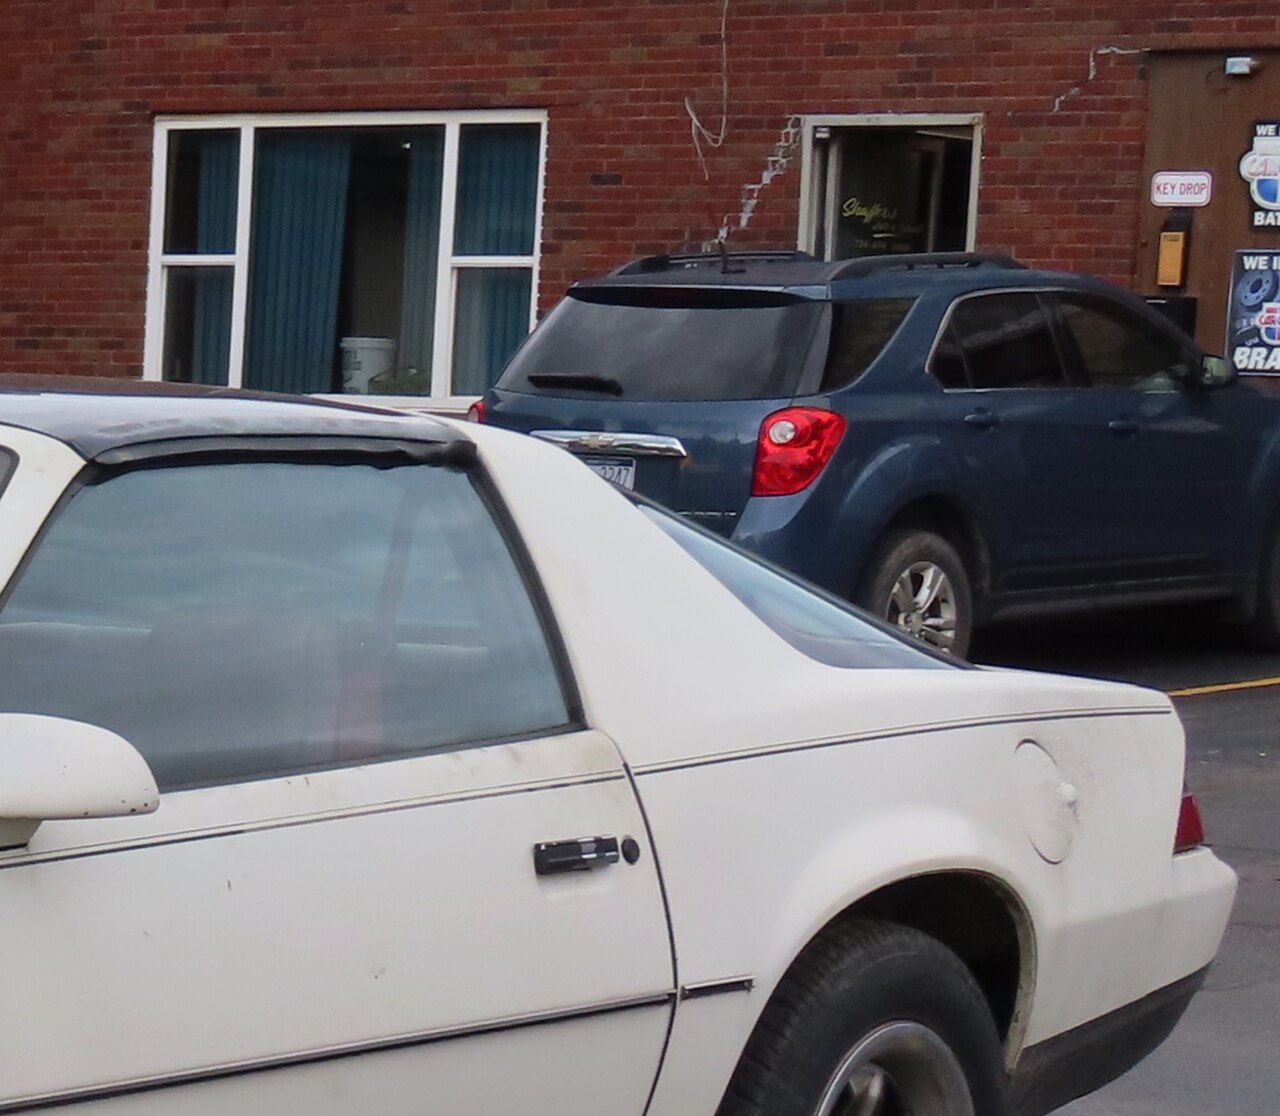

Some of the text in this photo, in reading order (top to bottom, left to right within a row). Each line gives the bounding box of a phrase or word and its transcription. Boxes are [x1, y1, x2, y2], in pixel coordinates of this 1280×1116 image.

[1256, 124, 1278, 136] WE
[1155, 182, 1207, 195] KEY DROP
[1243, 255, 1269, 270] WE
